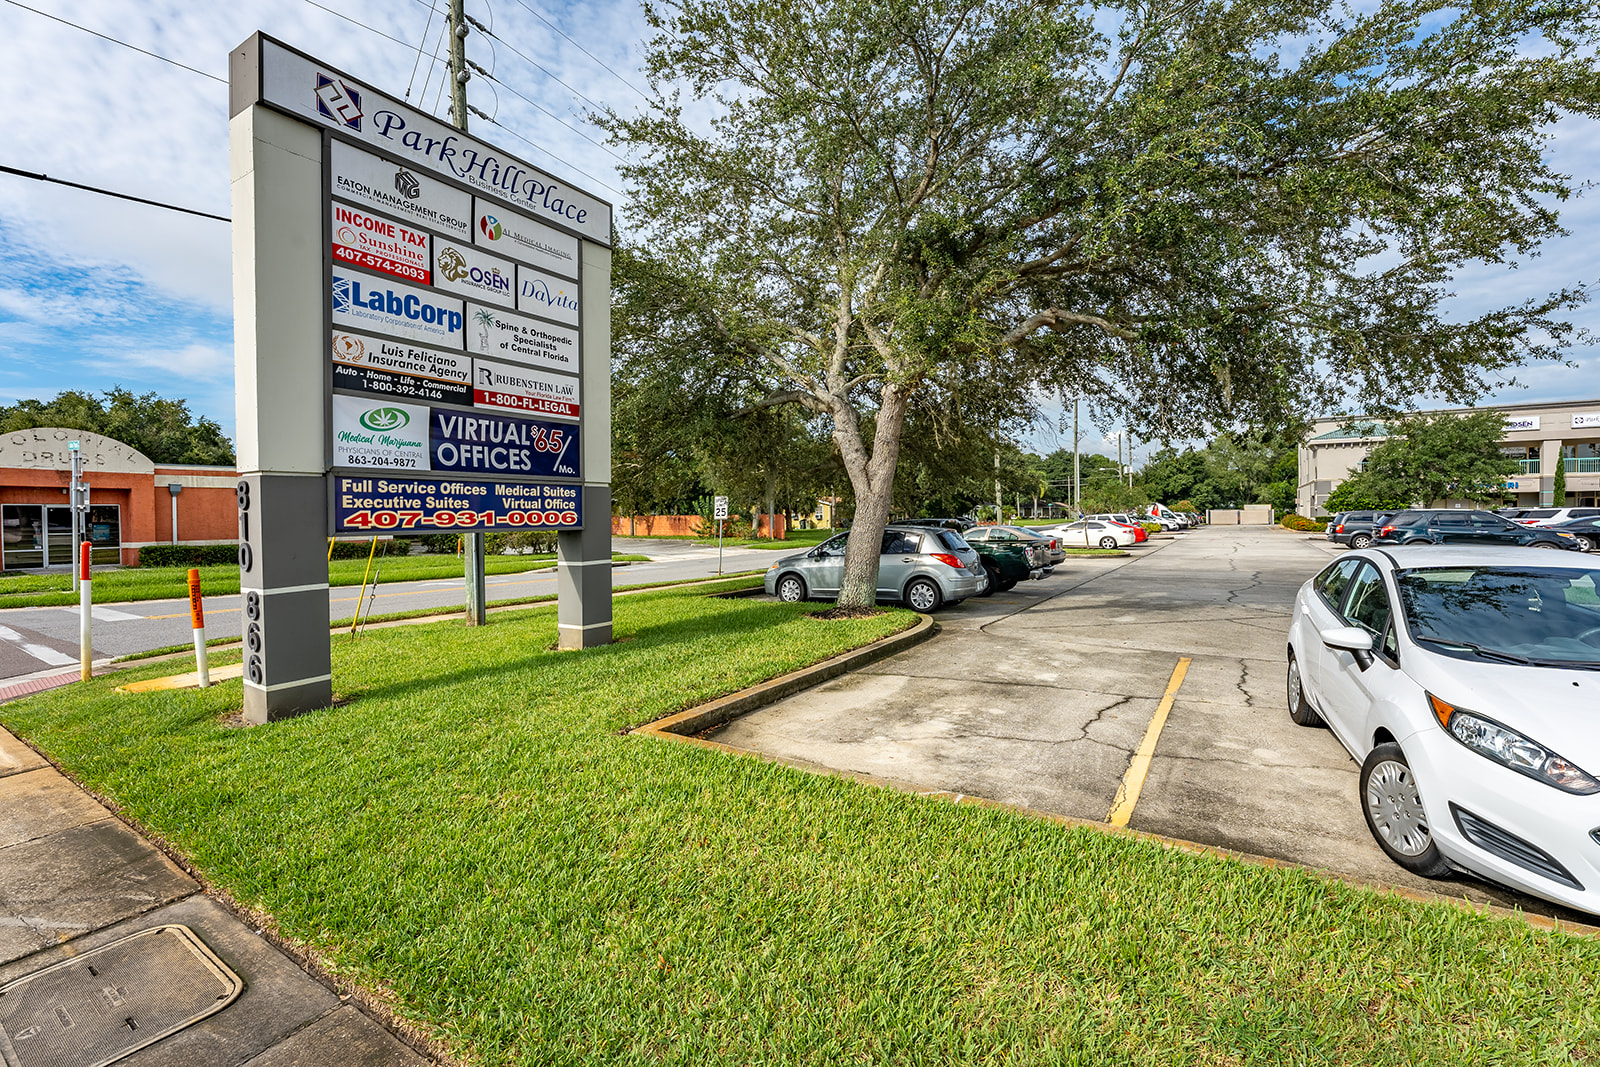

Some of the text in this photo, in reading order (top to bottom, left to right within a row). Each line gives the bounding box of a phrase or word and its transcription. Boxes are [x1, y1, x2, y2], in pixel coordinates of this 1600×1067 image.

[374, 110, 588, 224] Park Hill Place
[336, 184, 375, 201] COMMERCIAL
[376, 200, 414, 216] MANAGEMENT
[337, 176, 468, 230] EATON MANAGEMENT GROUP
[468, 174, 537, 210] Business Center
[336, 207, 426, 248] INCOME TAX
[359, 232, 424, 261] Sunshine
[336, 247, 425, 280] 407-574-2093
[376, 250, 424, 268] PROFESSIONALS
[460, 278, 486, 292] INSURANCE
[487, 286, 502, 294] GROUP
[522, 280, 578, 312] DaVita
[352, 280, 462, 333] LabCorp
[352, 308, 384, 322] Laboratory
[384, 316, 416, 329] Corporation
[424, 326, 445, 336] America
[495, 320, 572, 346] Spine & Orthopedic
[512, 344, 540, 356] Central
[543, 350, 569, 362] Florida
[514, 334, 557, 351] Specialists
[368, 352, 468, 380] Insurance Agency
[382, 344, 457, 368] Luis Feliciano
[336, 366, 358, 376] Auto
[366, 370, 392, 382] Home
[400, 376, 415, 385] Life
[422, 380, 466, 393] Commercial
[362, 380, 442, 399] 1-800-392-4146
[496, 374, 554, 392] RUBENSTEIN
[556, 385, 574, 396] LAW
[484, 392, 572, 414] 1-800-FL-LEGAL
[338, 430, 422, 449] Medical Marijuana
[438, 414, 530, 446] VIRTUAL
[338, 446, 380, 456] PHYSICIANS
[394, 450, 422, 458] CENTRAL
[348, 455, 416, 468] 863-204-9872
[437, 442, 532, 470] OFFICES
[342, 480, 487, 495] Full Service Offices
[495, 484, 576, 497] Medical Suites
[342, 496, 470, 508] Executive Suites
[502, 498, 576, 509] Virtual Office
[716, 508, 726, 516] 25
[344, 510, 578, 528] 407-931-0006
